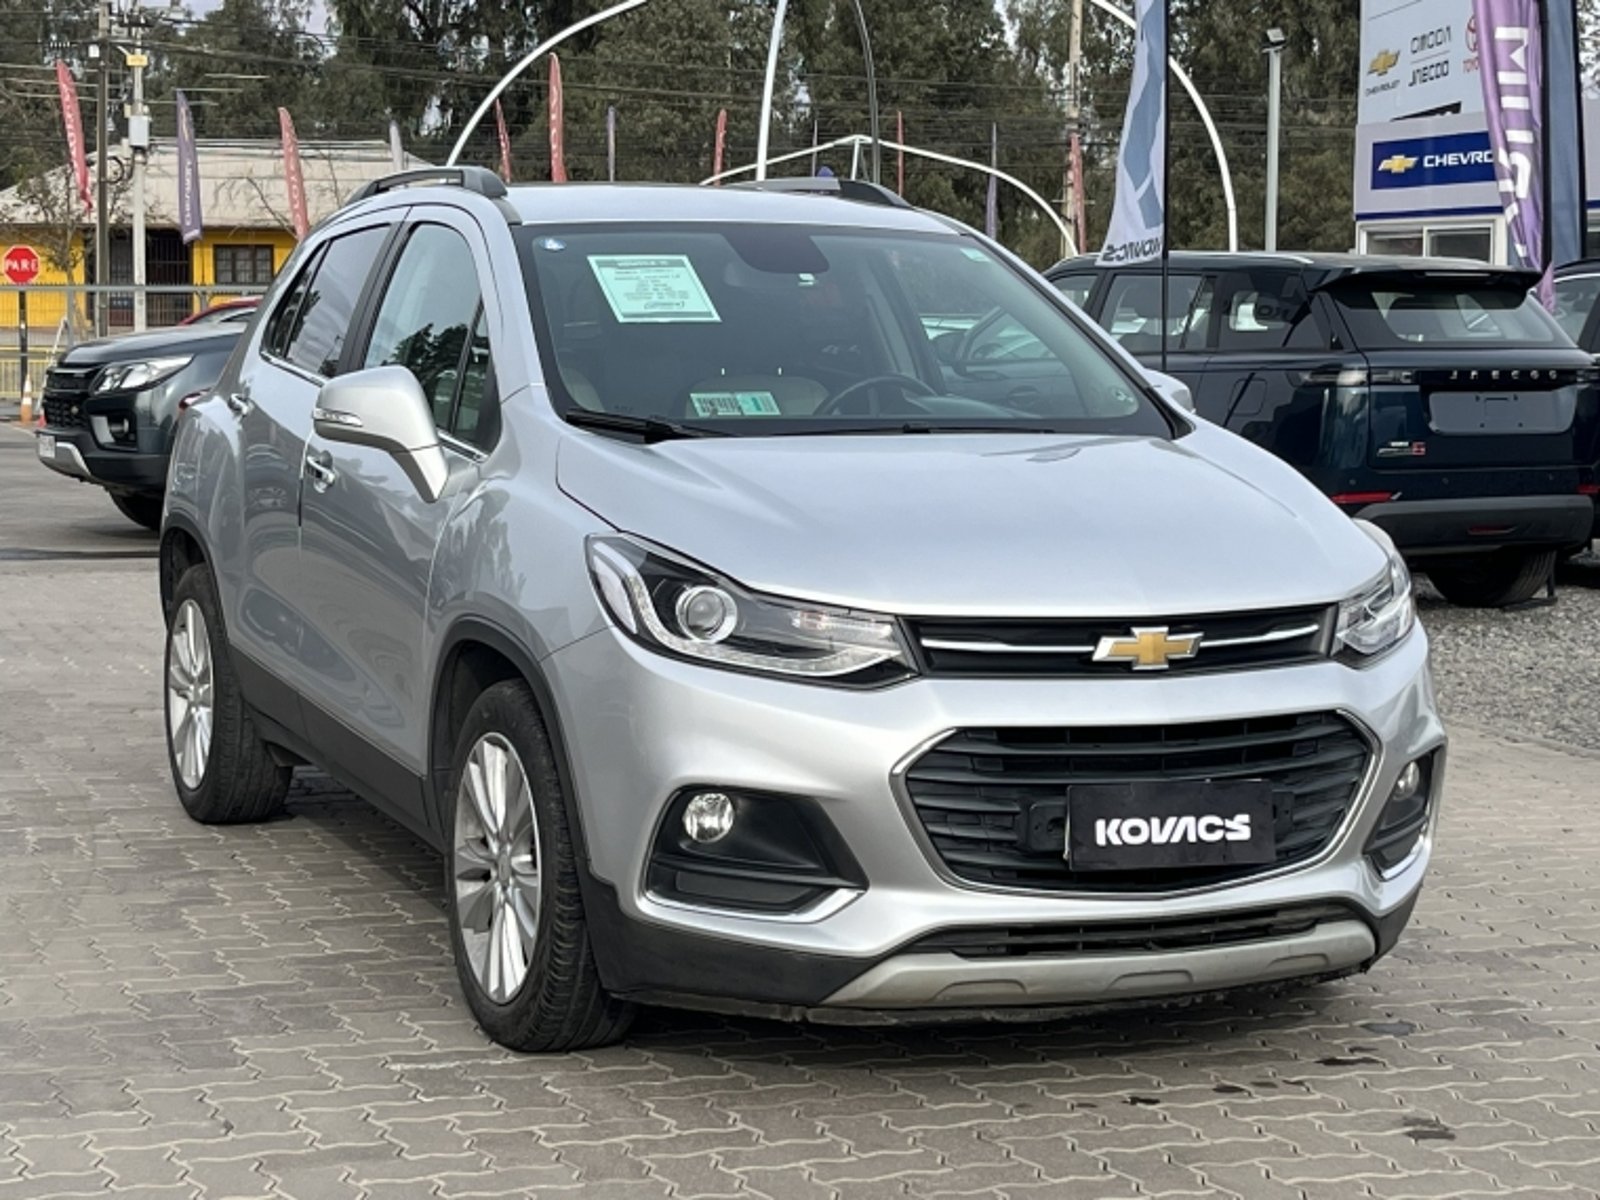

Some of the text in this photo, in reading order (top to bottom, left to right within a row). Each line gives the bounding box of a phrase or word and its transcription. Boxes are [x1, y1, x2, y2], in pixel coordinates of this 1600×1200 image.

[1423, 150, 1494, 168] CHEVRO
[5, 259, 38, 272] PARE
[1095, 814, 1251, 846] KOVACS
